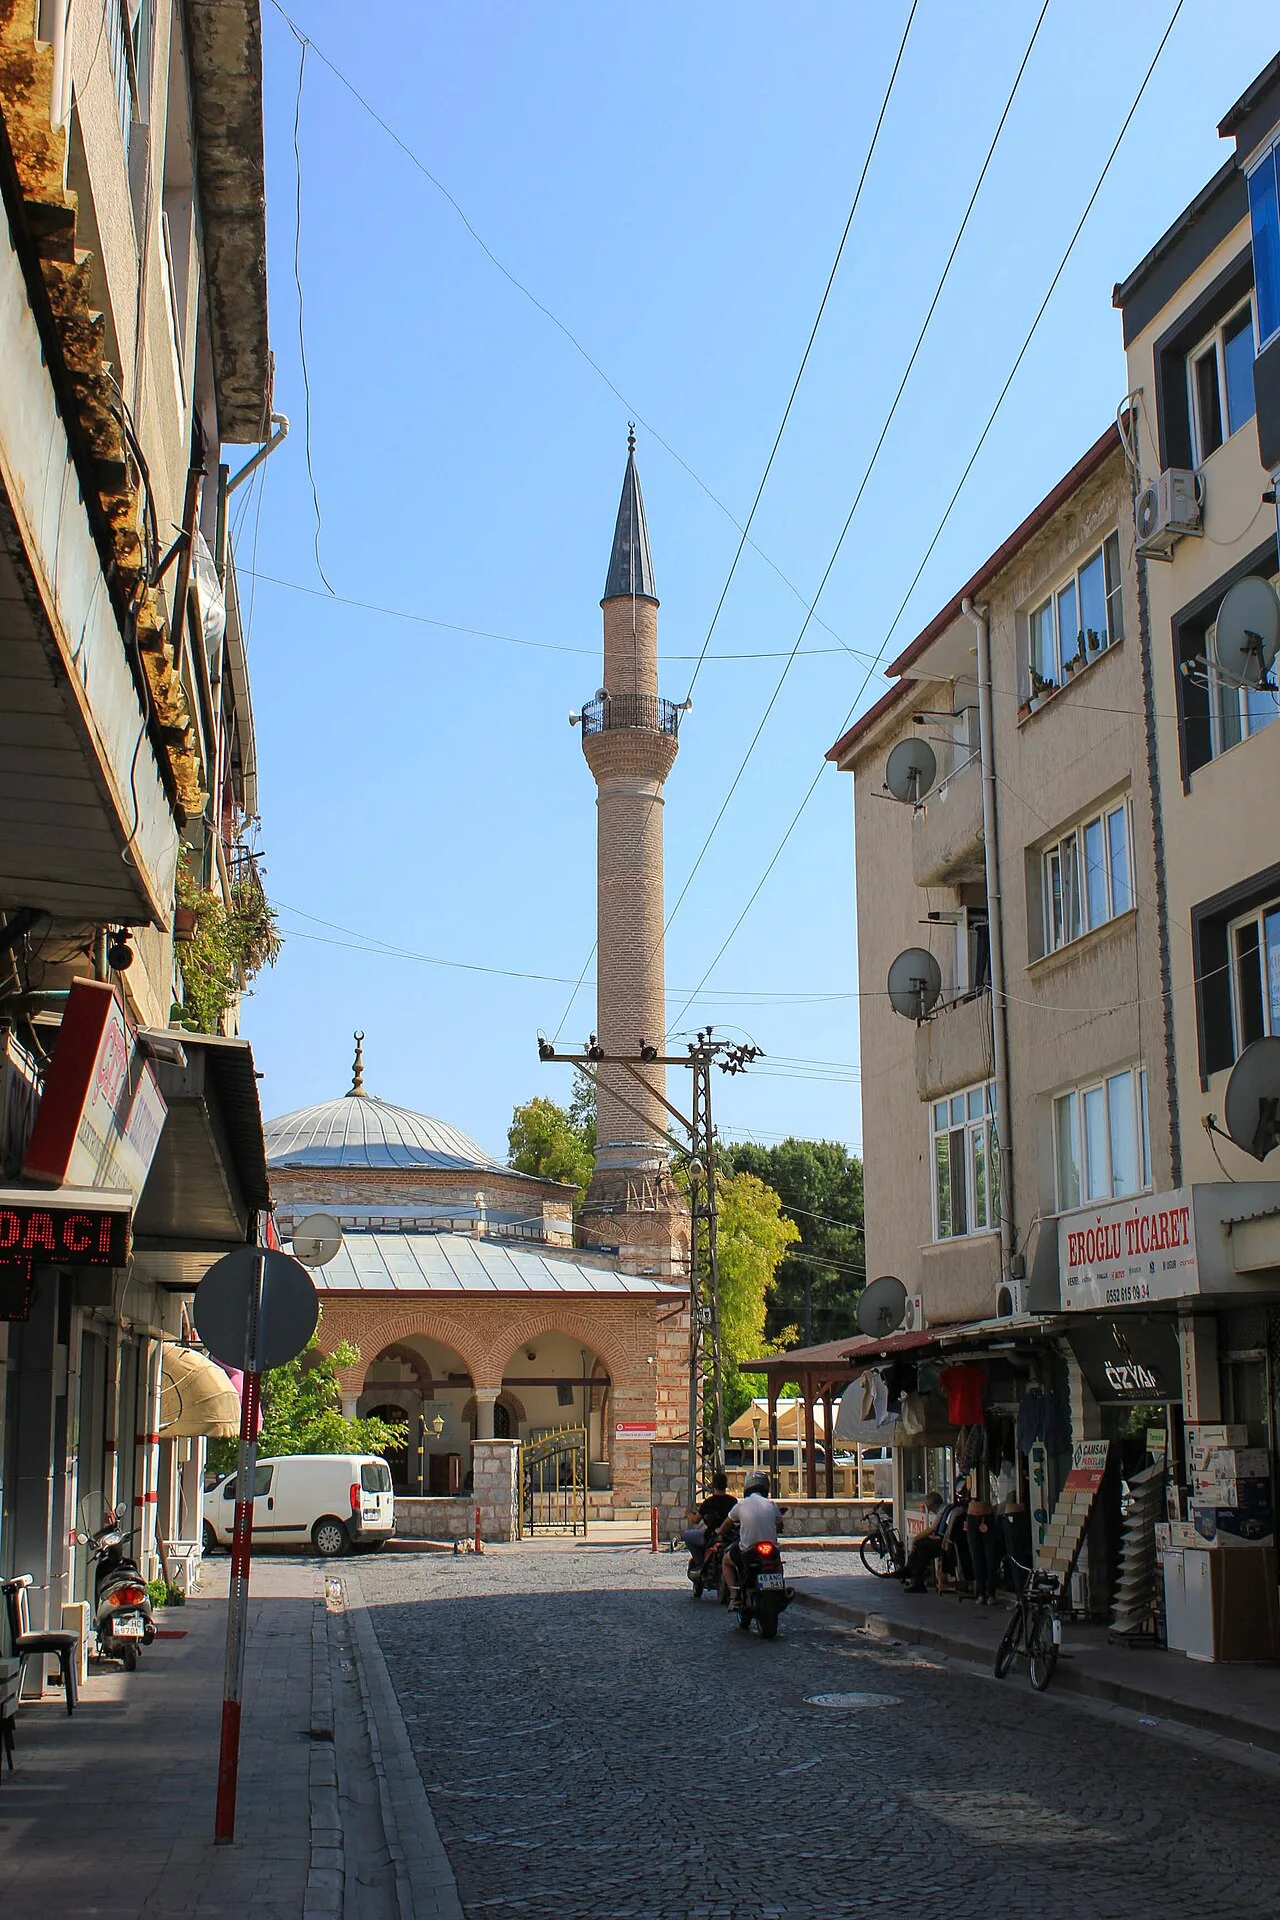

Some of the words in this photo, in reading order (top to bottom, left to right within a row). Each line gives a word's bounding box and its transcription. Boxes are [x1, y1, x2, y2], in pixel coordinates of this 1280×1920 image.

[1067, 1216, 1121, 1267] EROĞLU
[1125, 1207, 1190, 1255] TİCARET
[1106, 1288, 1120, 1303] 0552
[1121, 1286, 1132, 1301] 615
[1132, 1285, 1140, 1300] 09
[1141, 1284, 1150, 1298] 34
[1183, 1322, 1193, 1418] VESTEL
